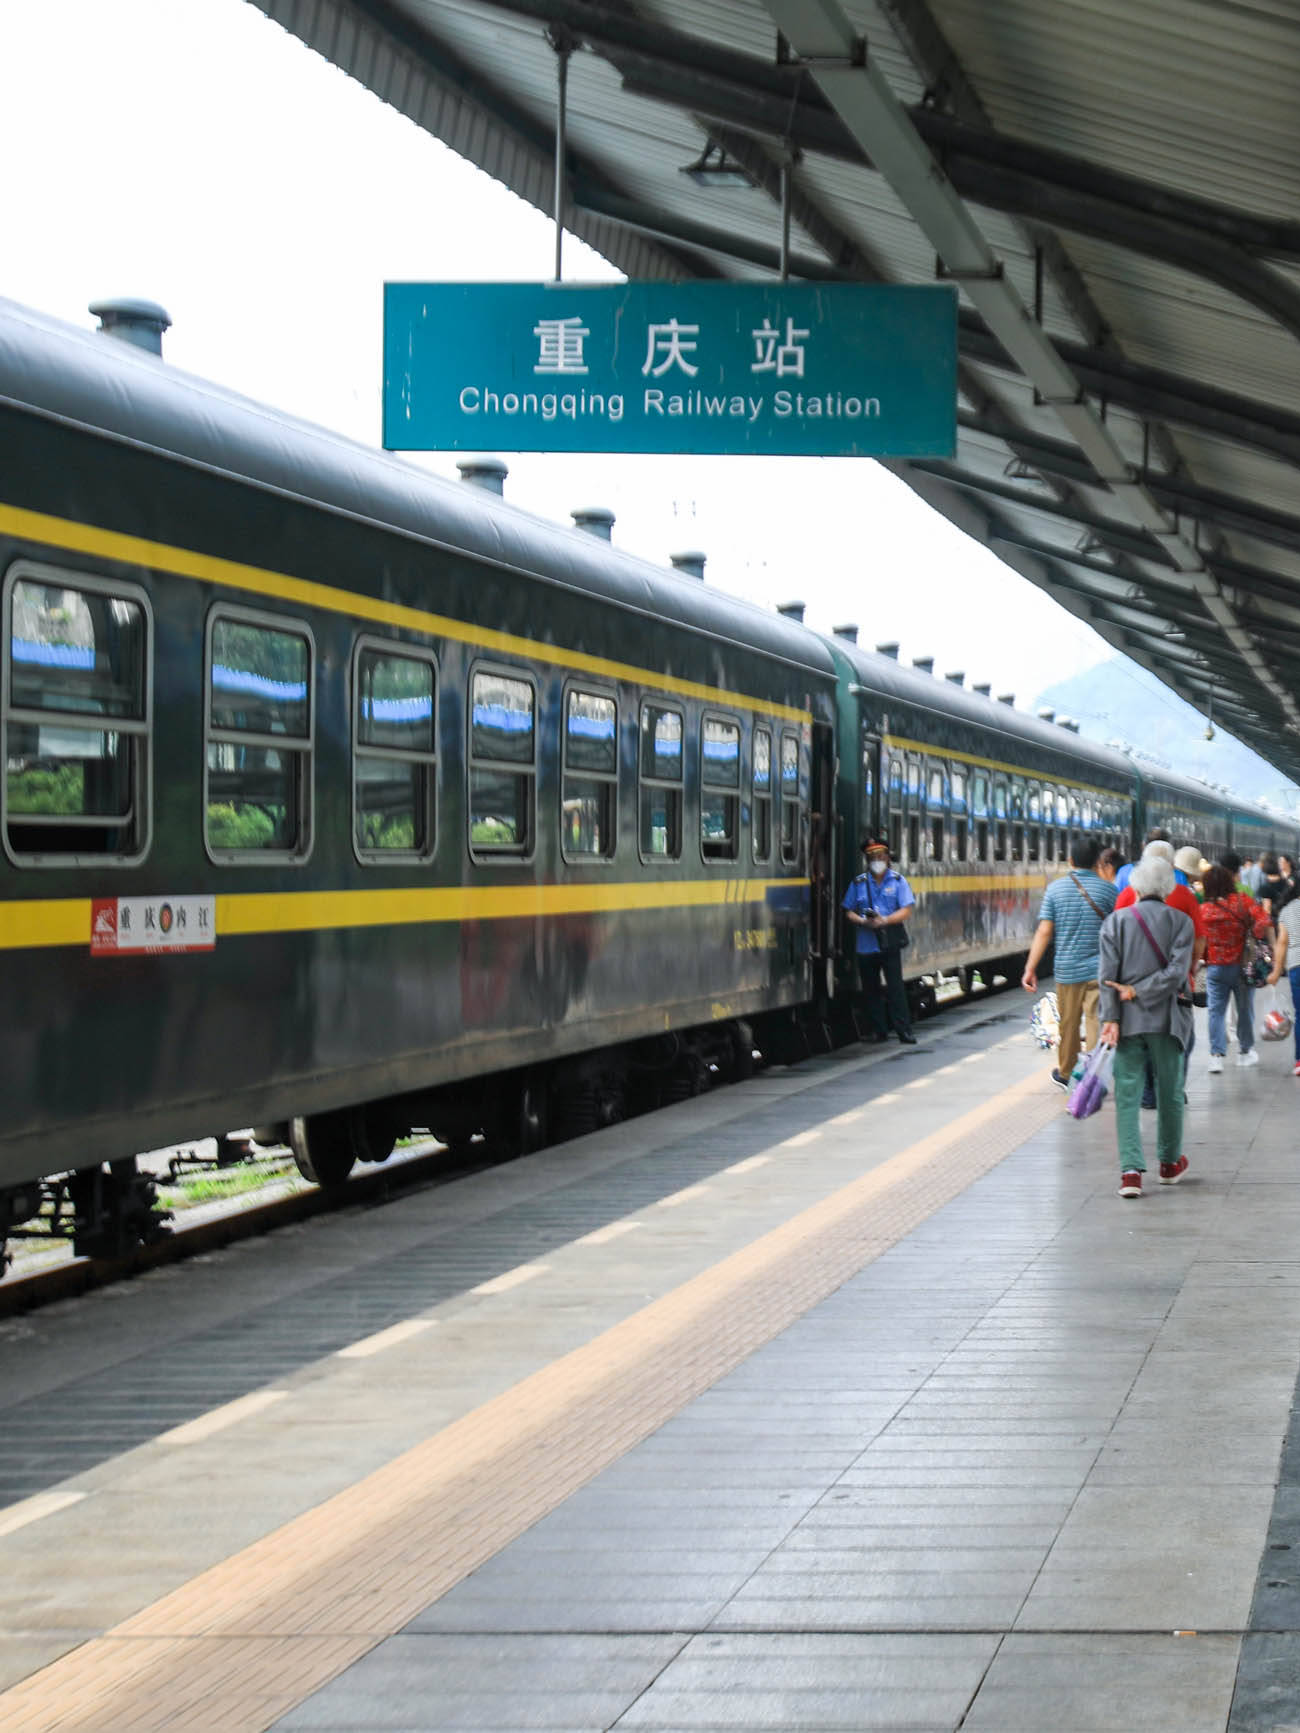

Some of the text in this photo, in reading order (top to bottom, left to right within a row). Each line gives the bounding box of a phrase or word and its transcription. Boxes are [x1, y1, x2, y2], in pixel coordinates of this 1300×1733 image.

[533, 316, 810, 378] 重庆站
[458, 386, 881, 421] Chongqing Railway Station
[120, 904, 209, 930] 重庆 内江
